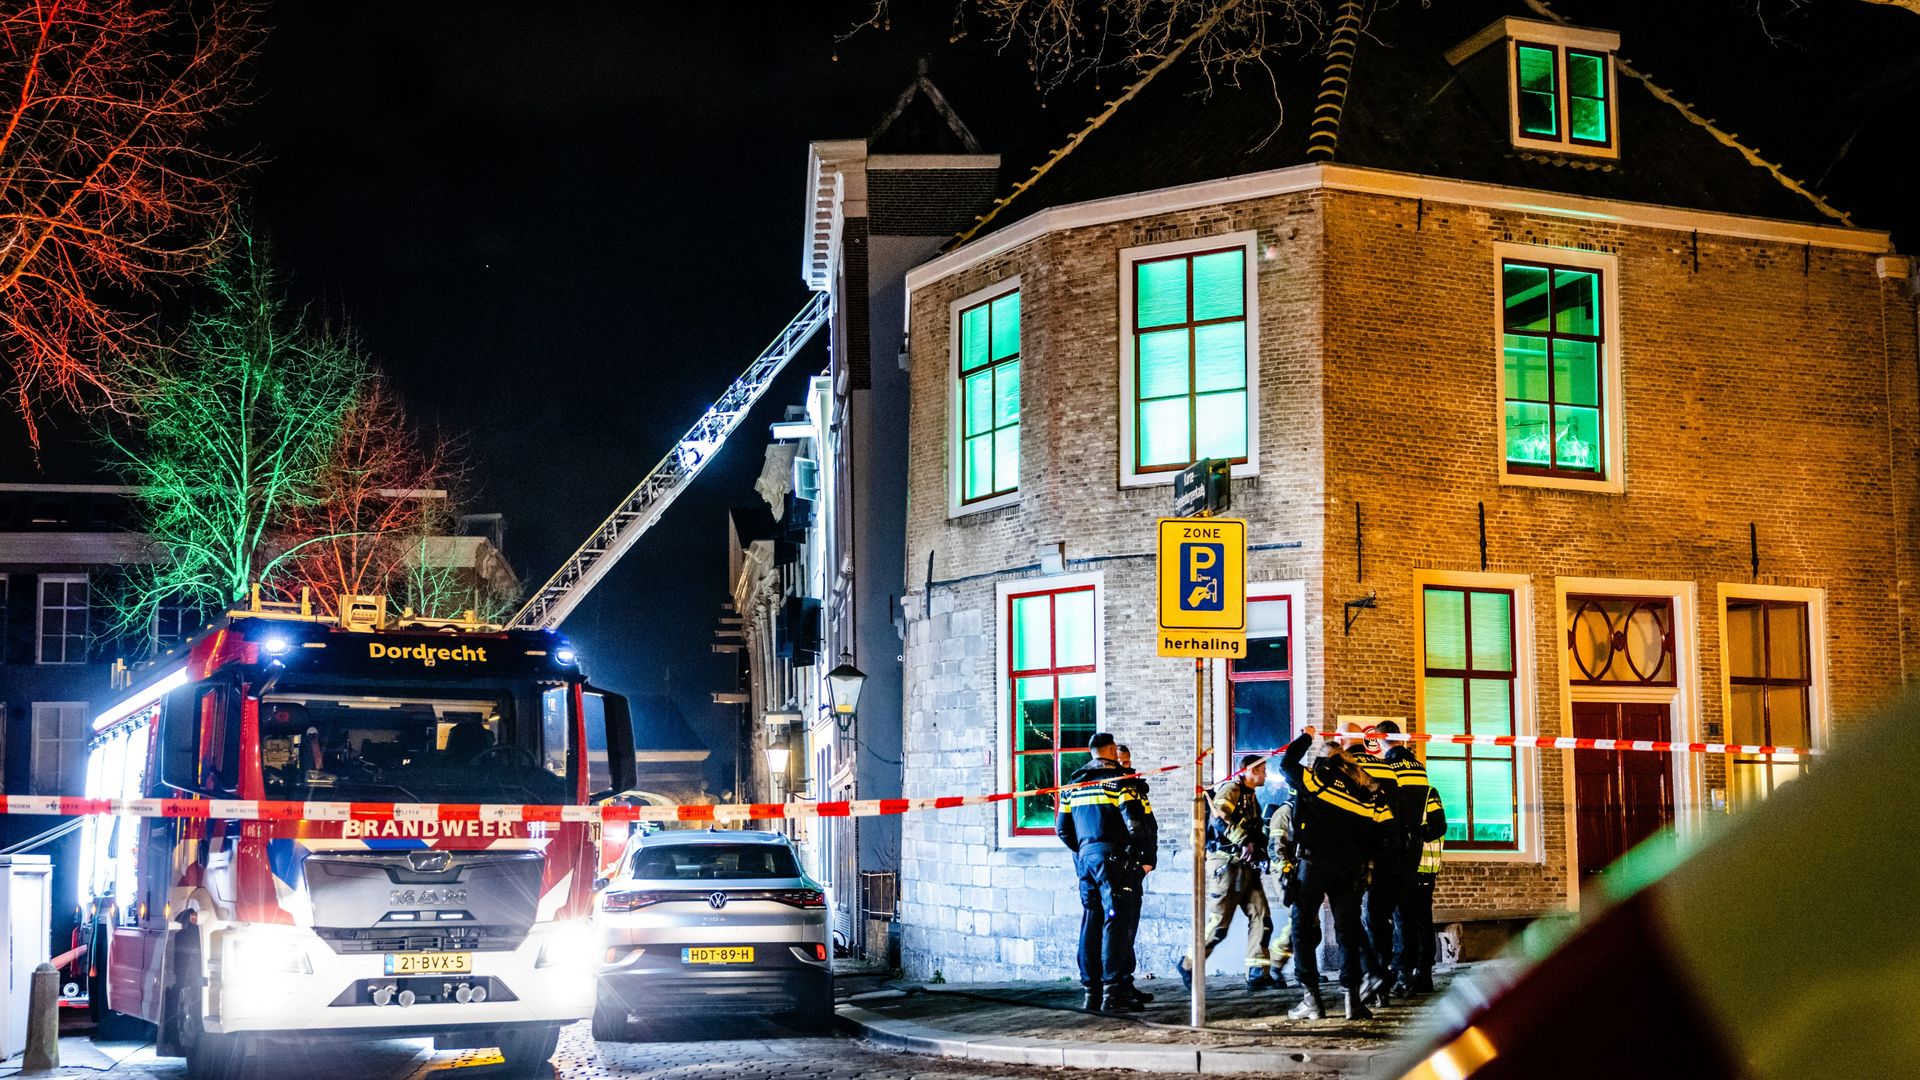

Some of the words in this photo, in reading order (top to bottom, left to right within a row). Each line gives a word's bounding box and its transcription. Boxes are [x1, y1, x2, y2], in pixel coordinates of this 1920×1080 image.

[1184, 528, 1221, 538] ZONE
[1190, 546, 1216, 582] P
[369, 642, 487, 662] Dordrecht
[1165, 637, 1239, 653] herhaling
[346, 820, 512, 837] BRANDWEER
[390, 889, 467, 905] MAN
[401, 956, 464, 969] 21-BVX-5
[691, 949, 749, 960] HDT-89-H
